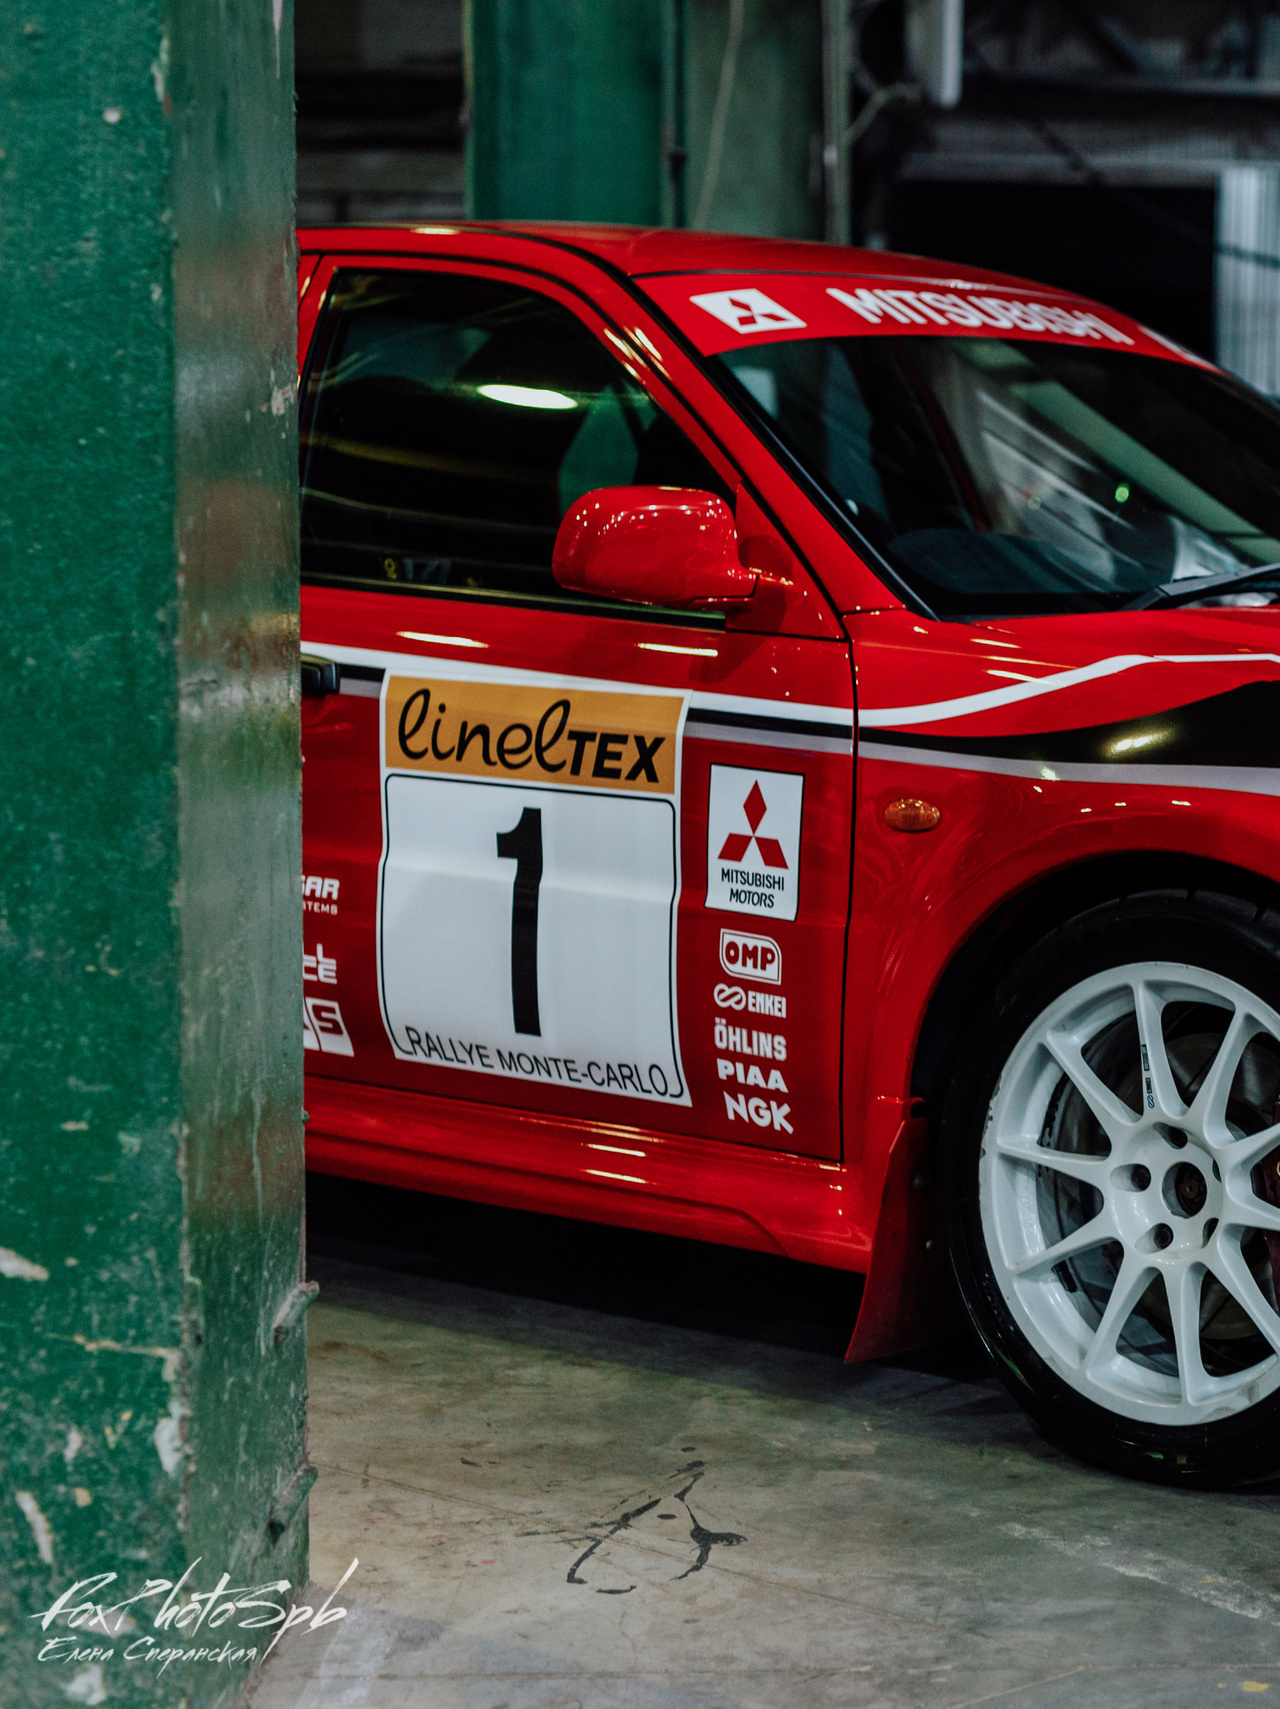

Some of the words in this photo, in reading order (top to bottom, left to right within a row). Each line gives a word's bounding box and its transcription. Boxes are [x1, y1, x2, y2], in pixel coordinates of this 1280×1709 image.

[826, 288, 1135, 346] MITSUBISHI
[721, 867, 785, 891] MITSUBISHI
[729, 887, 775, 909] MOTORS
[496, 806, 543, 1037] 1
[724, 940, 776, 971] OMP
[748, 990, 787, 1018] ENKEI
[714, 1017, 787, 1061] ÖHLINS
[405, 1026, 494, 1068] RALLYE
[496, 1049, 669, 1096] MONTE-CARLO
[716, 1058, 789, 1092] PIAA
[723, 1091, 794, 1135] NGK
